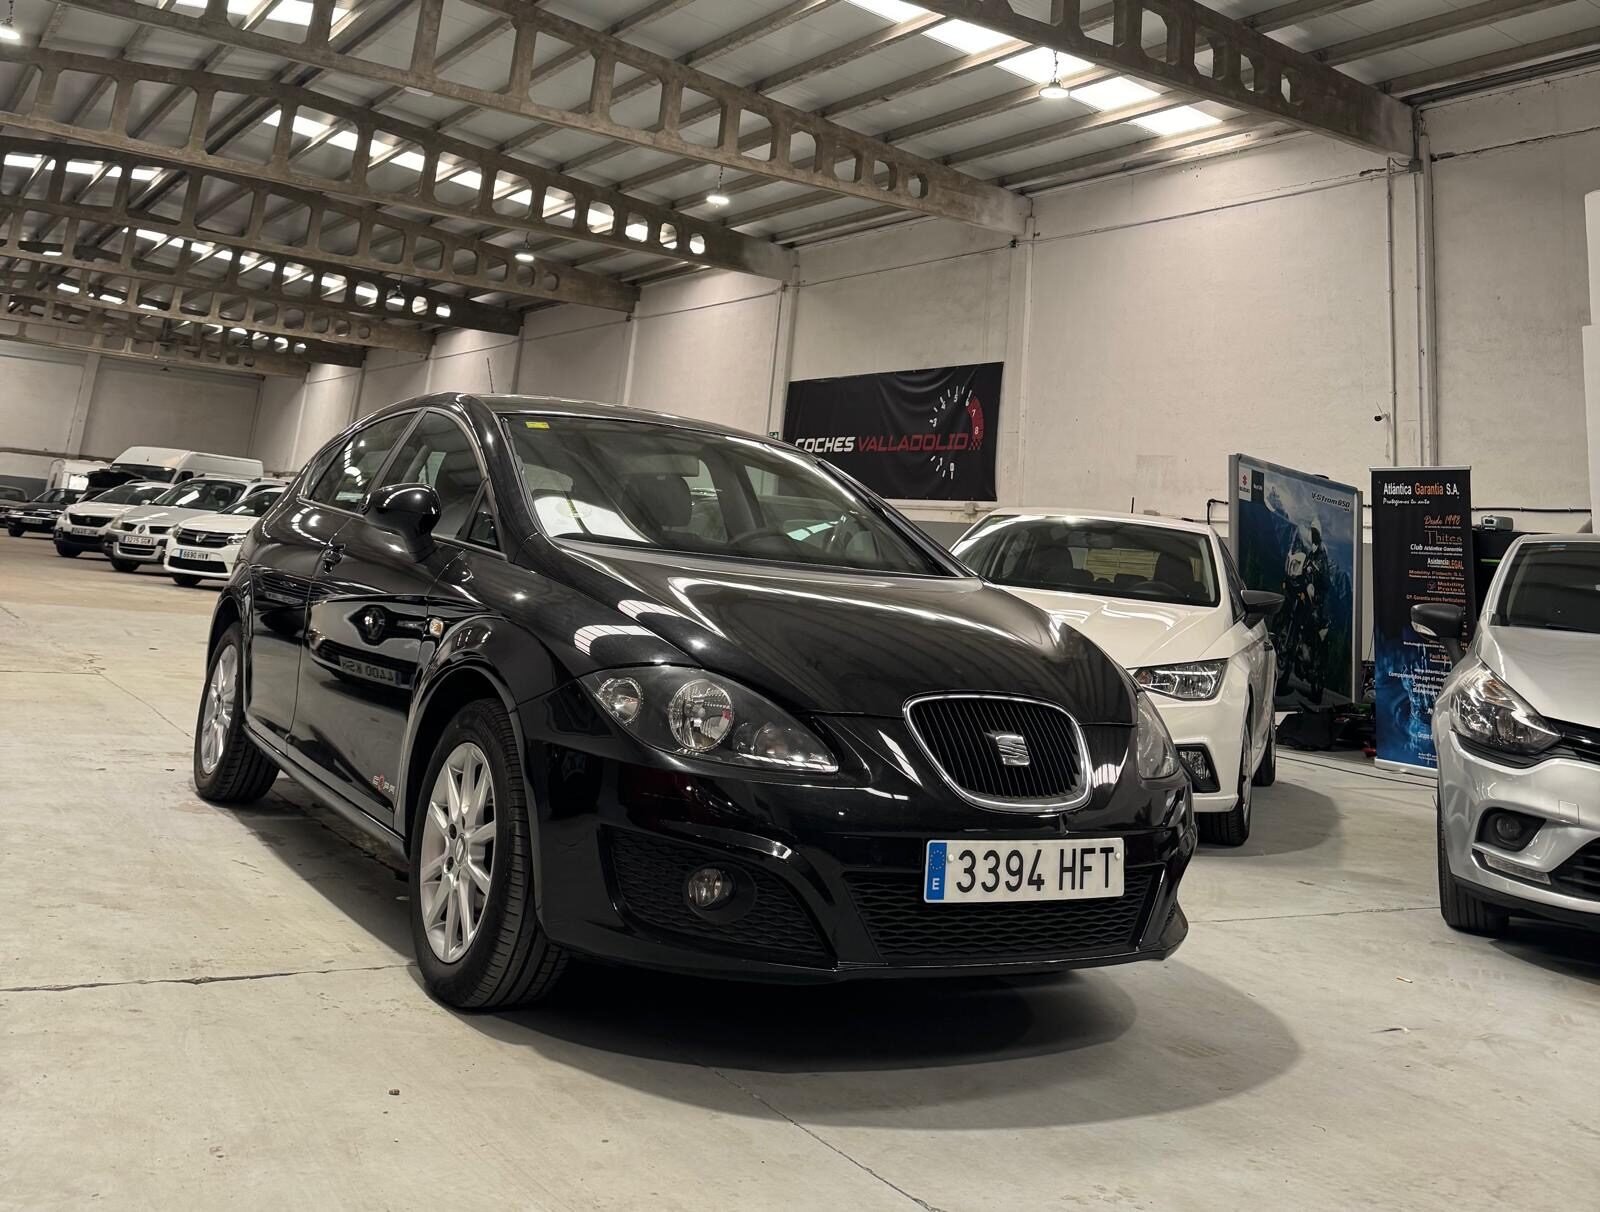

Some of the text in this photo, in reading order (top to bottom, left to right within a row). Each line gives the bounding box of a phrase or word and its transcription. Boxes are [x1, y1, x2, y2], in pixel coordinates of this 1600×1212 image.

[858, 432, 969, 453] VALLADOLID
[1383, 482, 1412, 495] Atlántica
[1446, 483, 1460, 495] S.A.
[1410, 543, 1424, 551] Club
[932, 846, 1115, 893] E 3394 HFT
